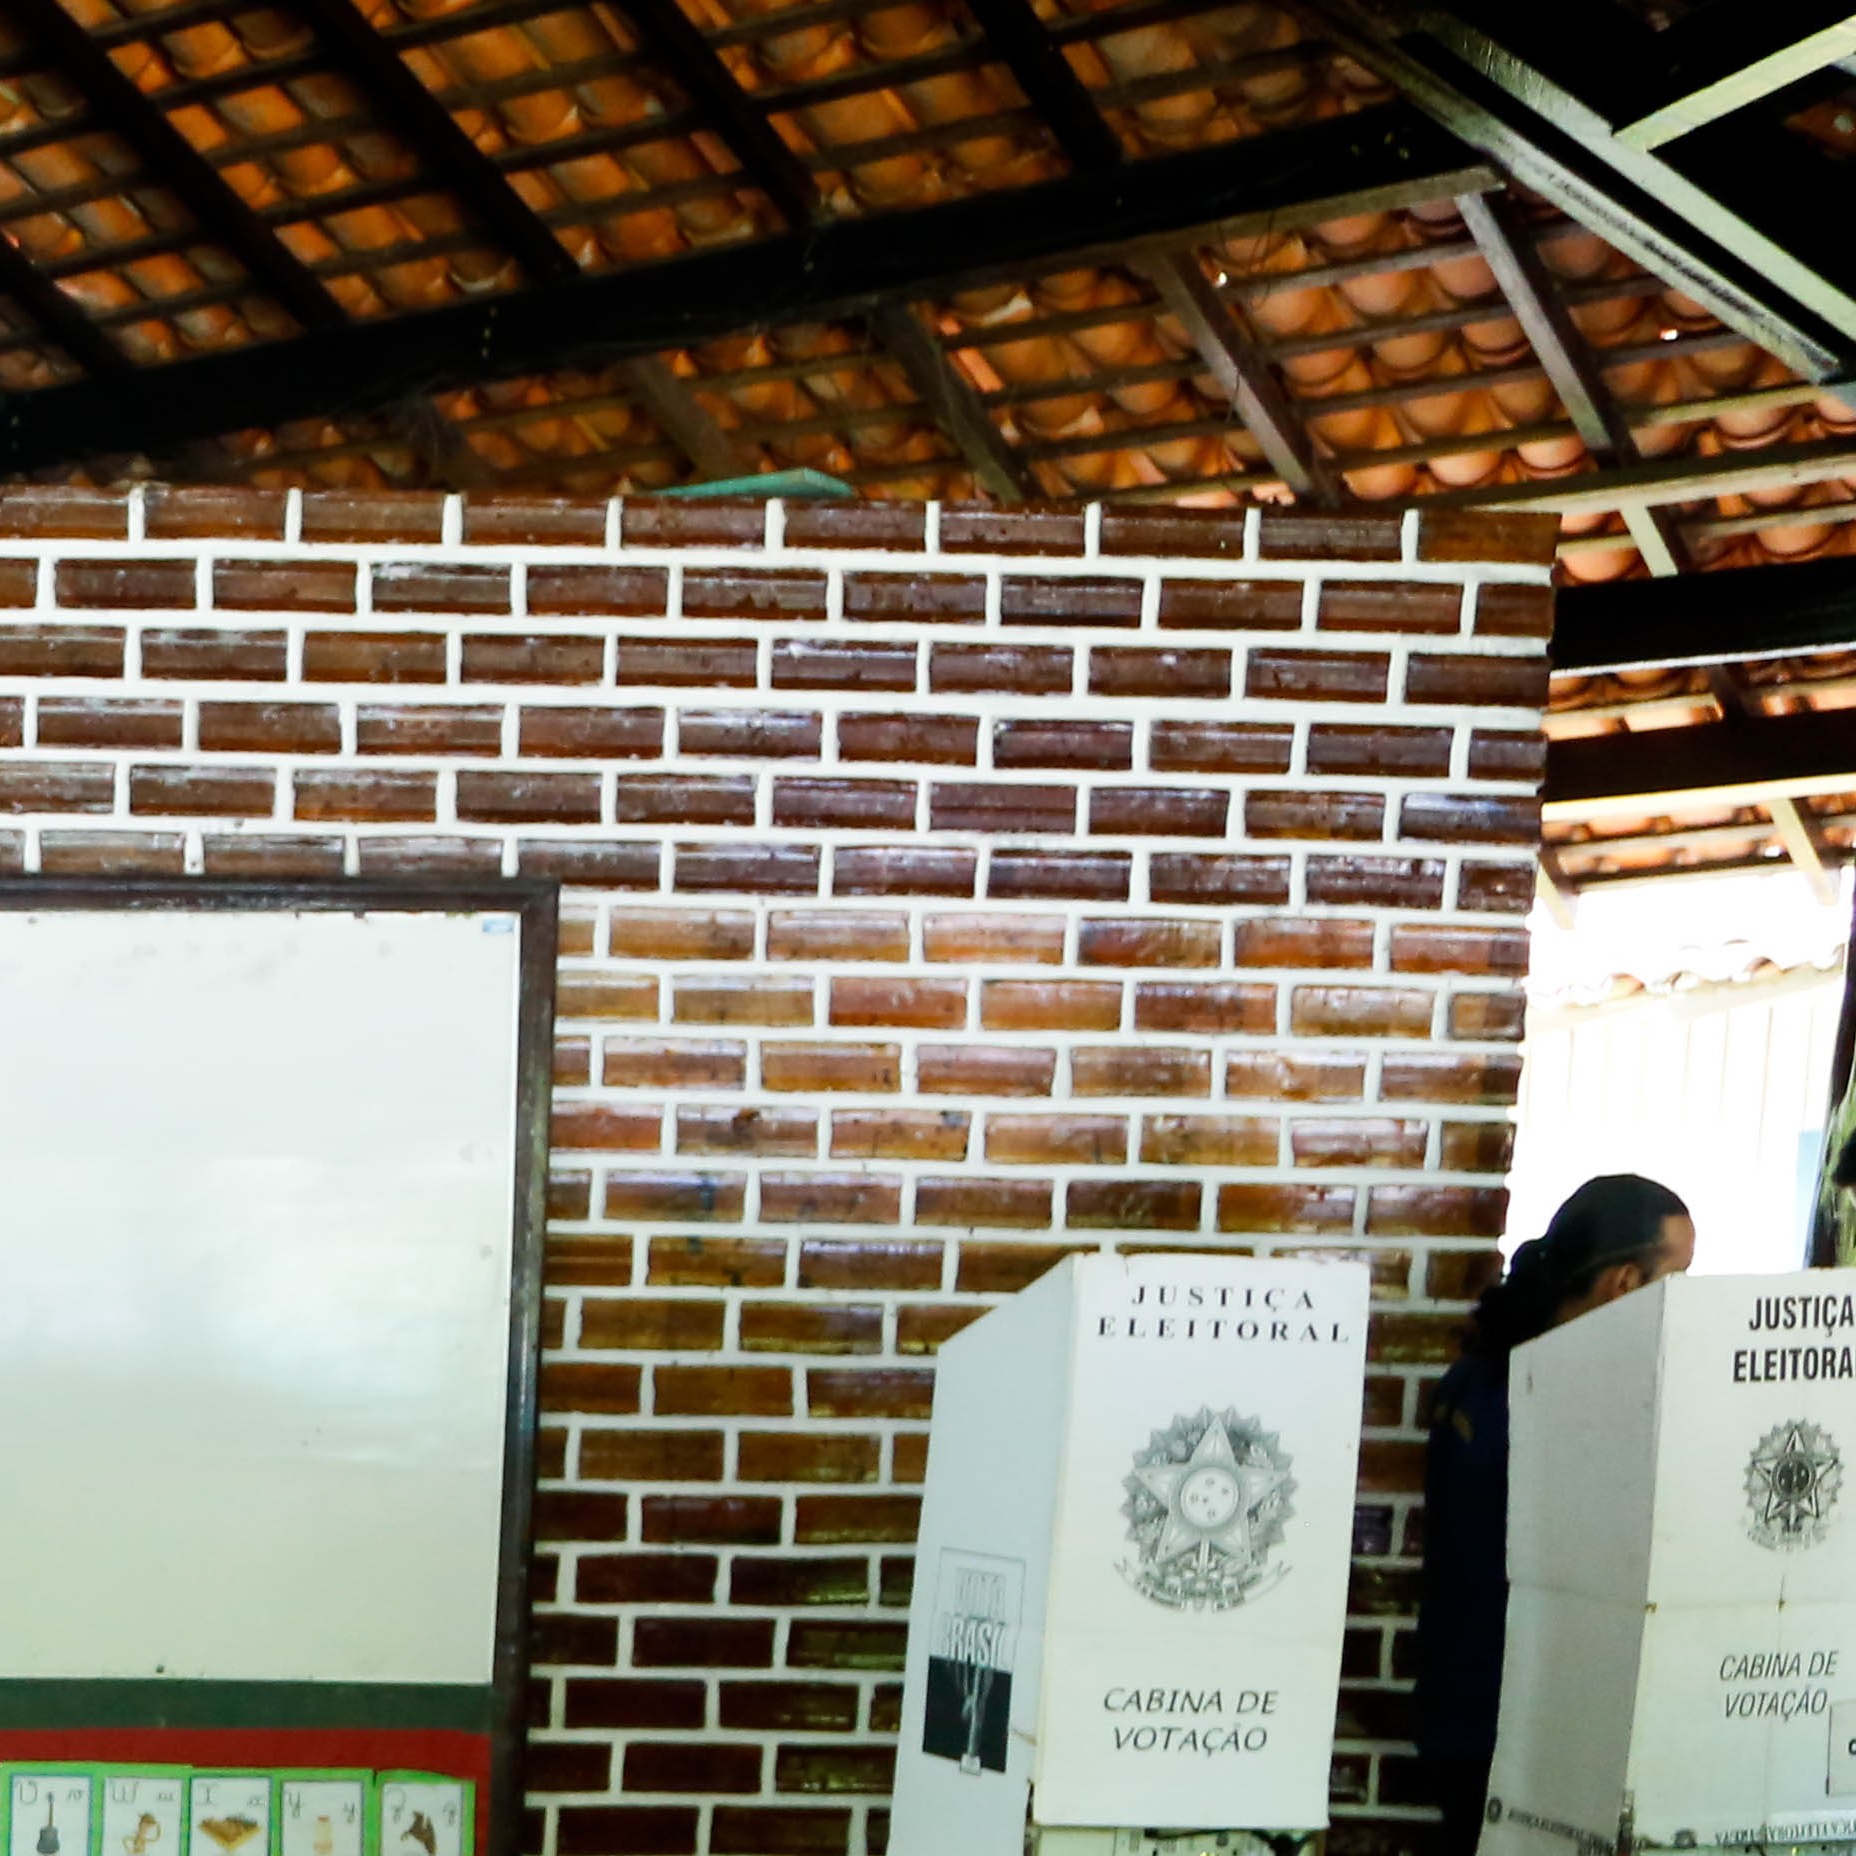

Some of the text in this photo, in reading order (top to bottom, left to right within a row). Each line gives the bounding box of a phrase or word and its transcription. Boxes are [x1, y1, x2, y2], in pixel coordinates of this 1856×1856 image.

[1132, 1285, 1313, 1312] JUSTIÇA
[1098, 1316, 1349, 1343] ELEITORAL
[1749, 1295, 1854, 1337] JUSTIÇA
[1733, 1346, 1856, 1382] ELEITORA
[1720, 1651, 1839, 1681] CABINA DE
[1104, 1688, 1279, 1714] CABINA DE
[1725, 1685, 1828, 1722] VOTAÇÃO
[1114, 1723, 1268, 1757] VOTAÇÃO
